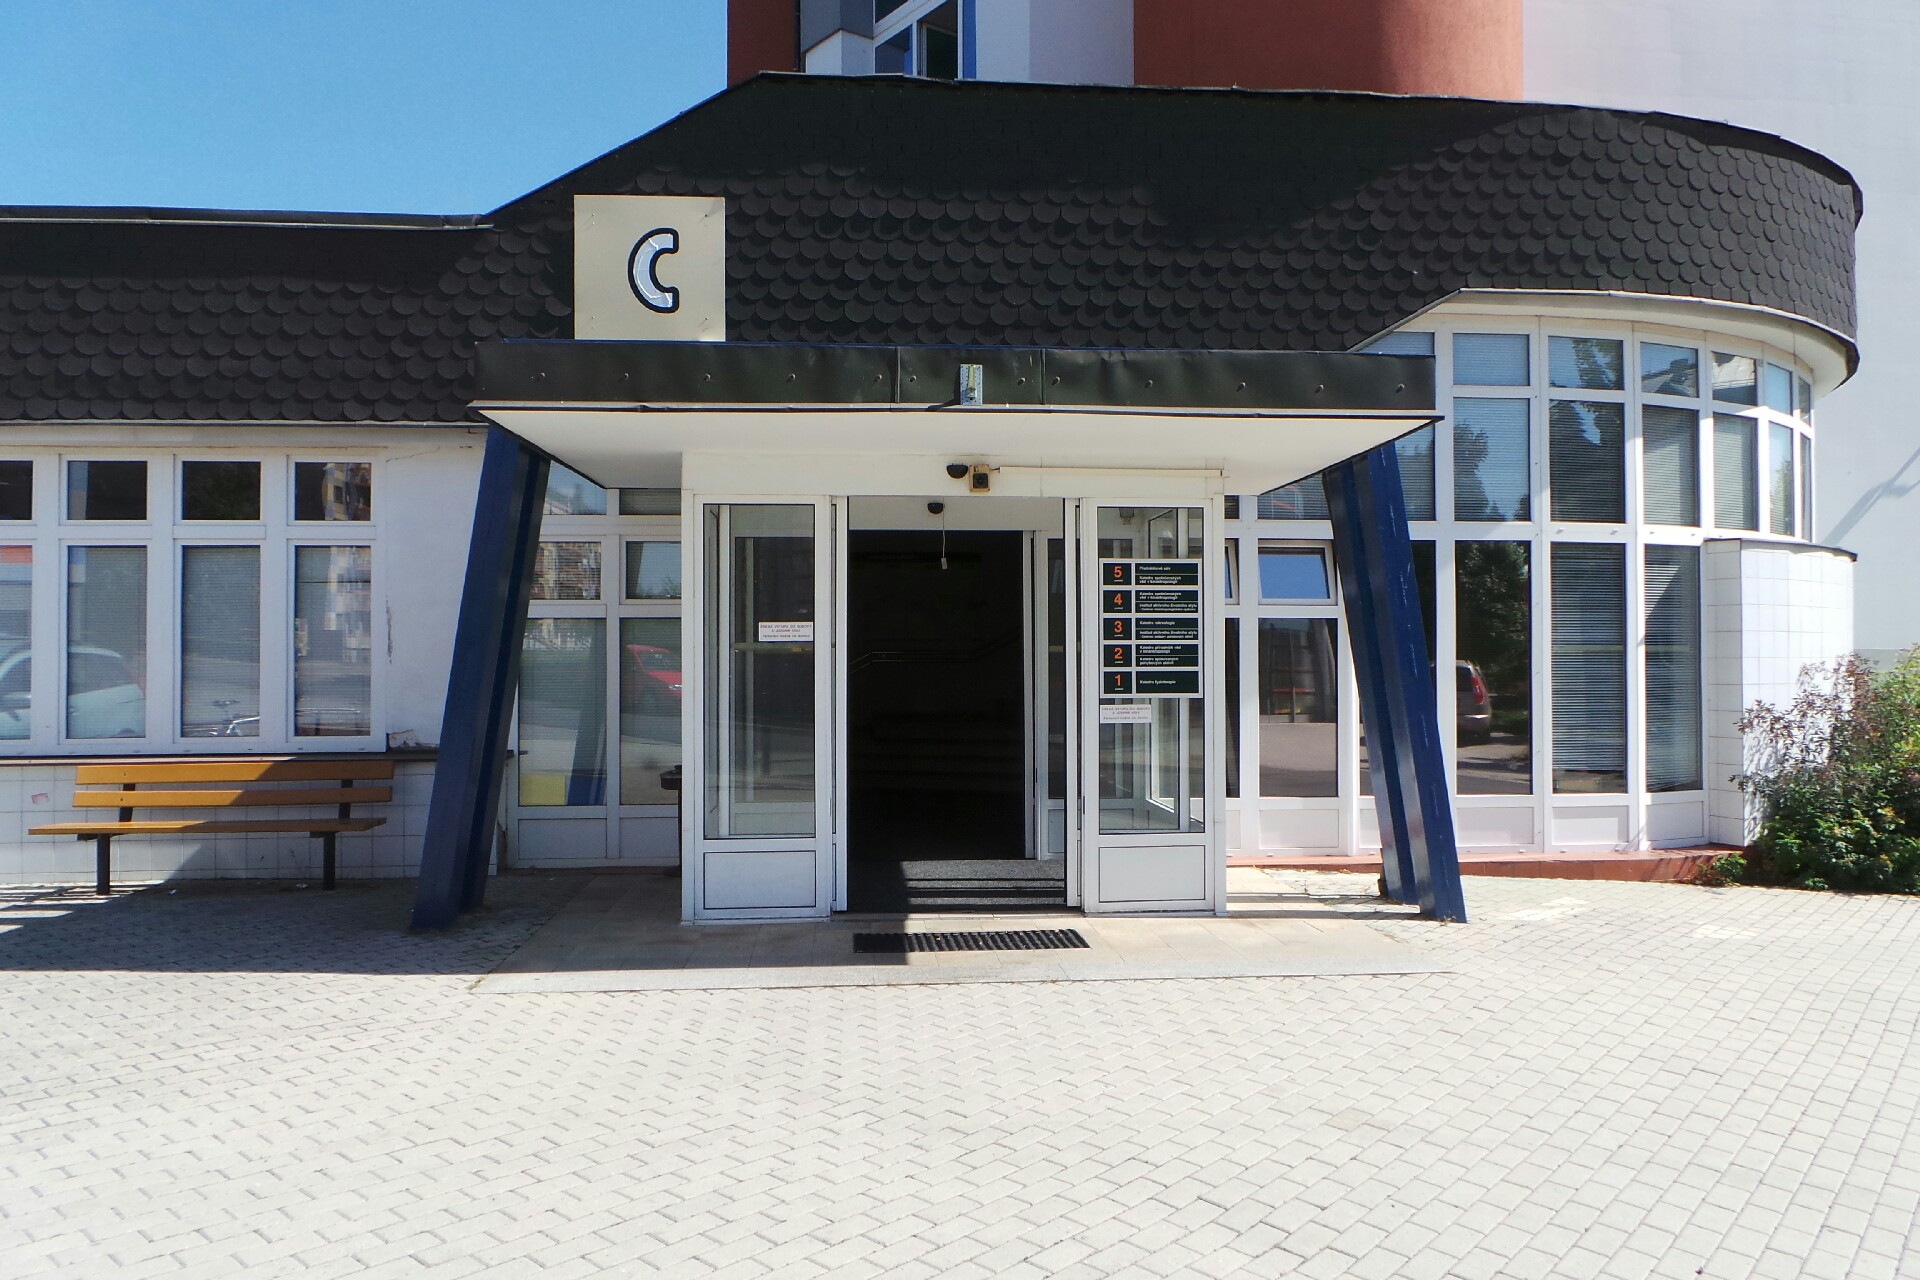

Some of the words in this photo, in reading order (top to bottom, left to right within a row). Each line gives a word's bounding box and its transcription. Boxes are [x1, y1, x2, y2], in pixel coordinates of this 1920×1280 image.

[628, 228, 679, 313] C
[1114, 566, 1122, 578] 5
[1114, 593, 1123, 605] 4
[1114, 620, 1123, 632] 3
[1114, 647, 1123, 659] 2
[1115, 674, 1121, 686] 1
